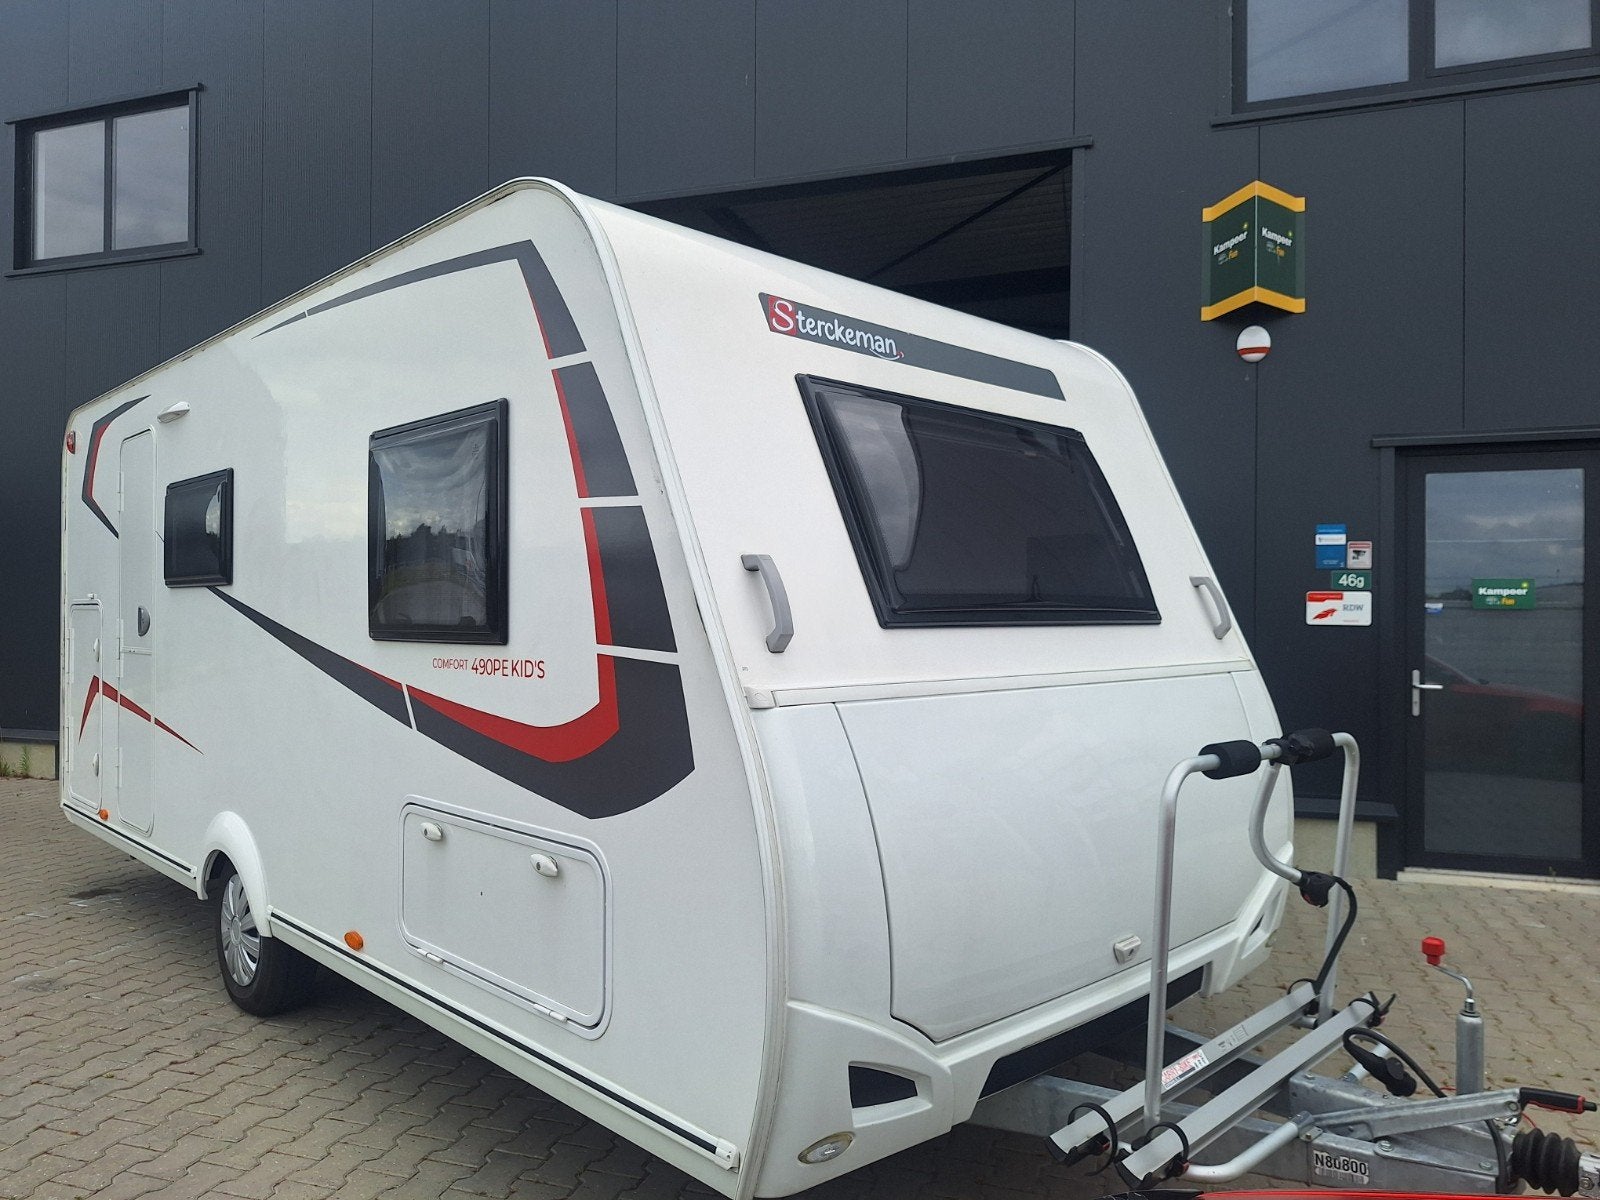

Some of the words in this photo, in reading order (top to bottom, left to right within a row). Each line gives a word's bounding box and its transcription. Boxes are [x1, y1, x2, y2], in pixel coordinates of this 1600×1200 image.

[772, 300, 898, 356] Sterckeman
[1338, 573, 1365, 589] 46g
[1478, 587, 1528, 597] Kampeer
[432, 657, 469, 671] COMFORT
[471, 657, 509, 677] 490PE
[511, 659, 545, 679] KID'S
[1315, 1153, 1367, 1175] N80800
